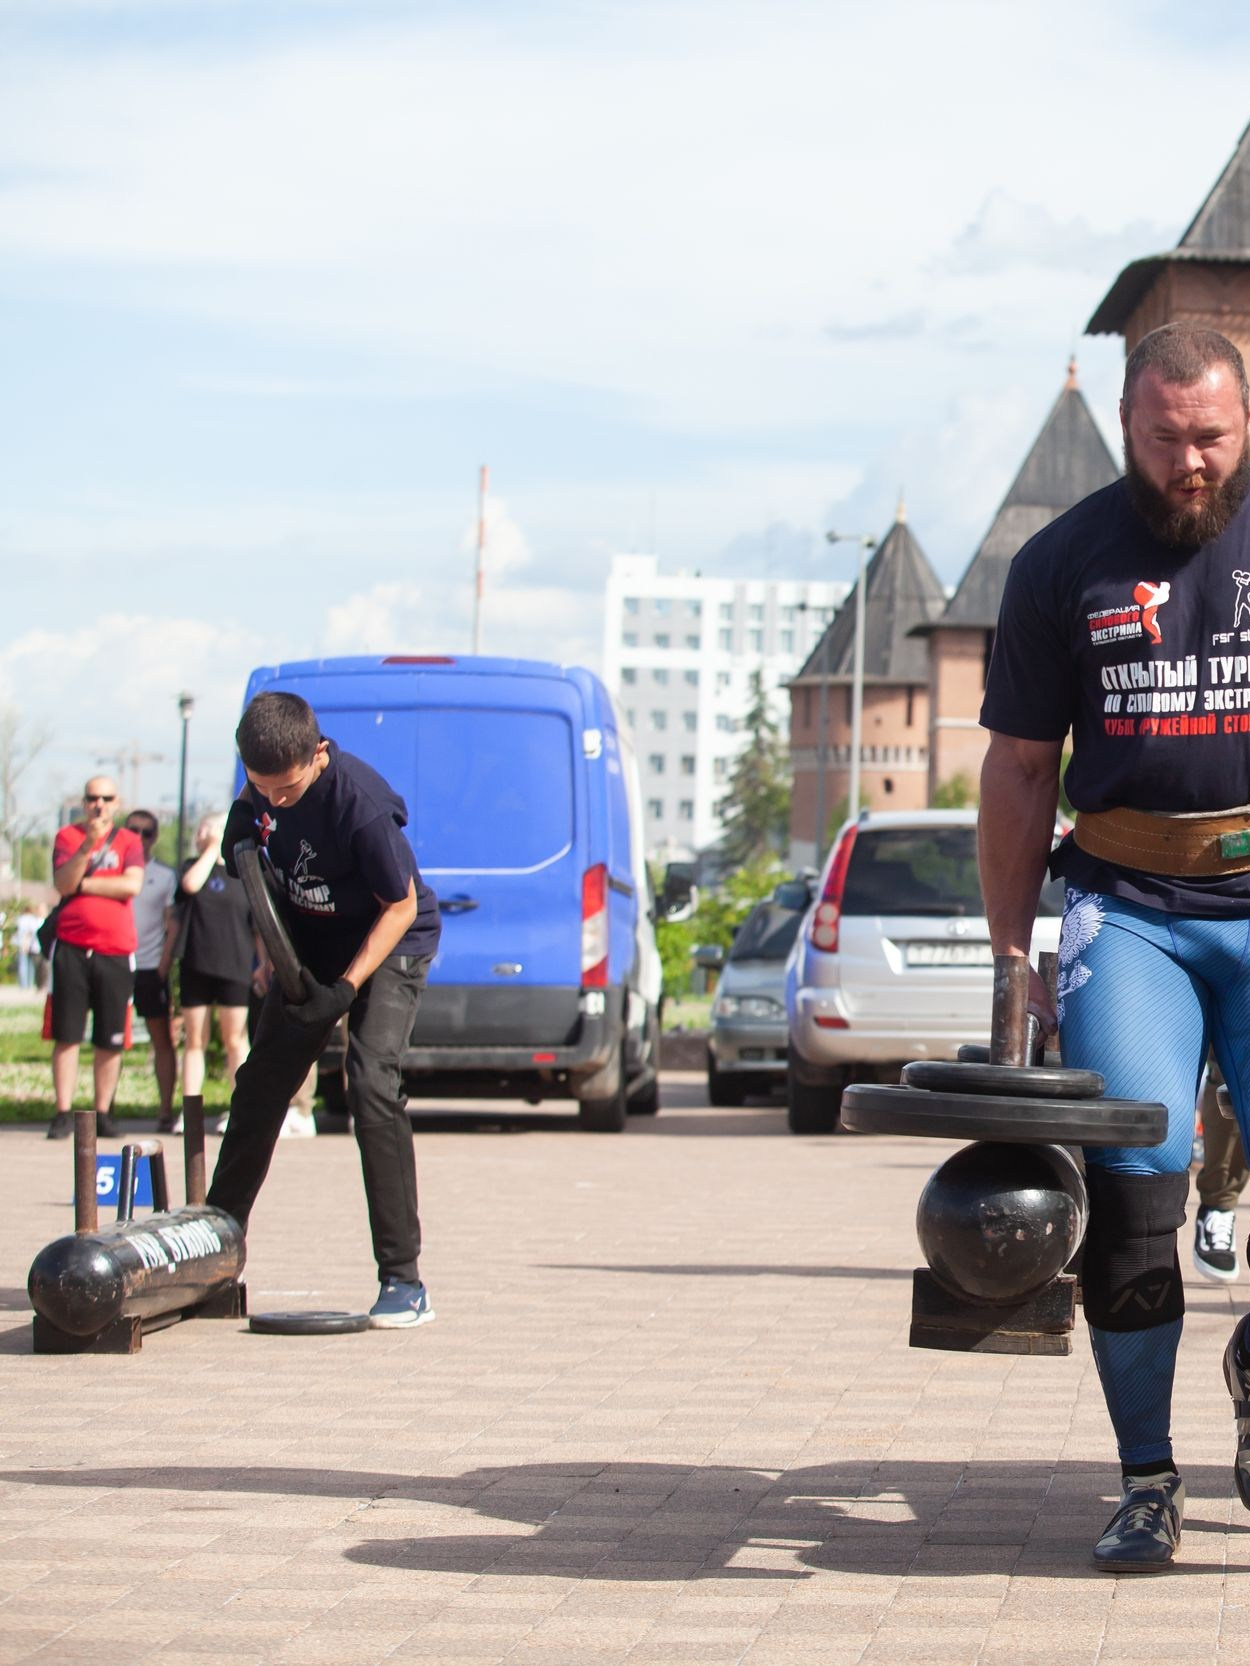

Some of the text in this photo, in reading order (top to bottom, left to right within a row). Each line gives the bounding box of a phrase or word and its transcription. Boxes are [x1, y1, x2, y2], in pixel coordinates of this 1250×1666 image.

[1091, 621, 1142, 642] ЭКСТРИМА
[1101, 654, 1197, 690] ОТКРЫТЫЙ
[1104, 694, 1122, 713] ПО
